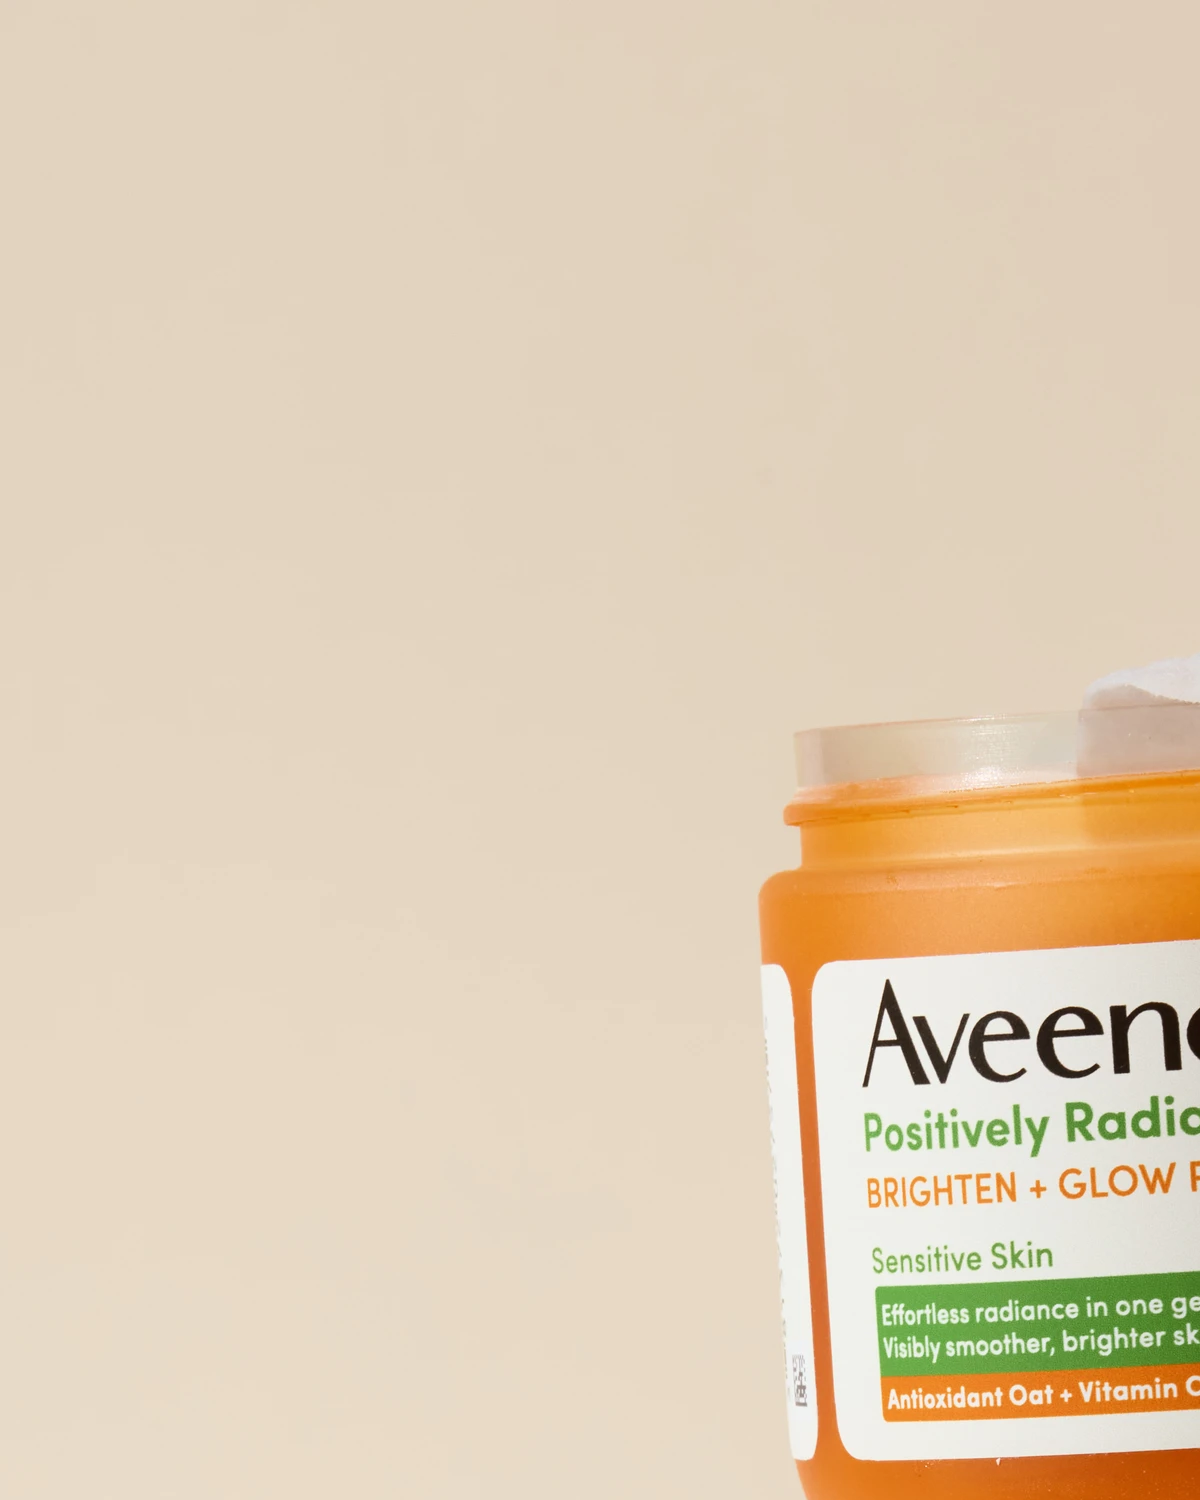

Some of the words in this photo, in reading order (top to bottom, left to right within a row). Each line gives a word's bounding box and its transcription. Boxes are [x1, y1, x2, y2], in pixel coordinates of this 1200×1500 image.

[864, 1104, 1050, 1157] Positively
[866, 1171, 1018, 1208] BRIGHTEN
[1029, 1180, 1048, 1199] +
[1058, 1161, 1177, 1199] GLOW
[871, 1244, 982, 1274] Sensitive
[991, 1242, 1054, 1269] Skin
[881, 1302, 970, 1328] Effortless
[975, 1297, 1079, 1323] radiance
[1086, 1295, 1109, 1318] in
[1115, 1296, 1164, 1317] one
[882, 1335, 941, 1364] Visibly
[945, 1331, 1056, 1358] smoother,
[1062, 1323, 1166, 1357] brighter
[887, 1383, 1003, 1411] Antioxidant
[1008, 1383, 1054, 1407] Oat
[1060, 1388, 1073, 1402] +
[1078, 1378, 1178, 1403] Vitamin
